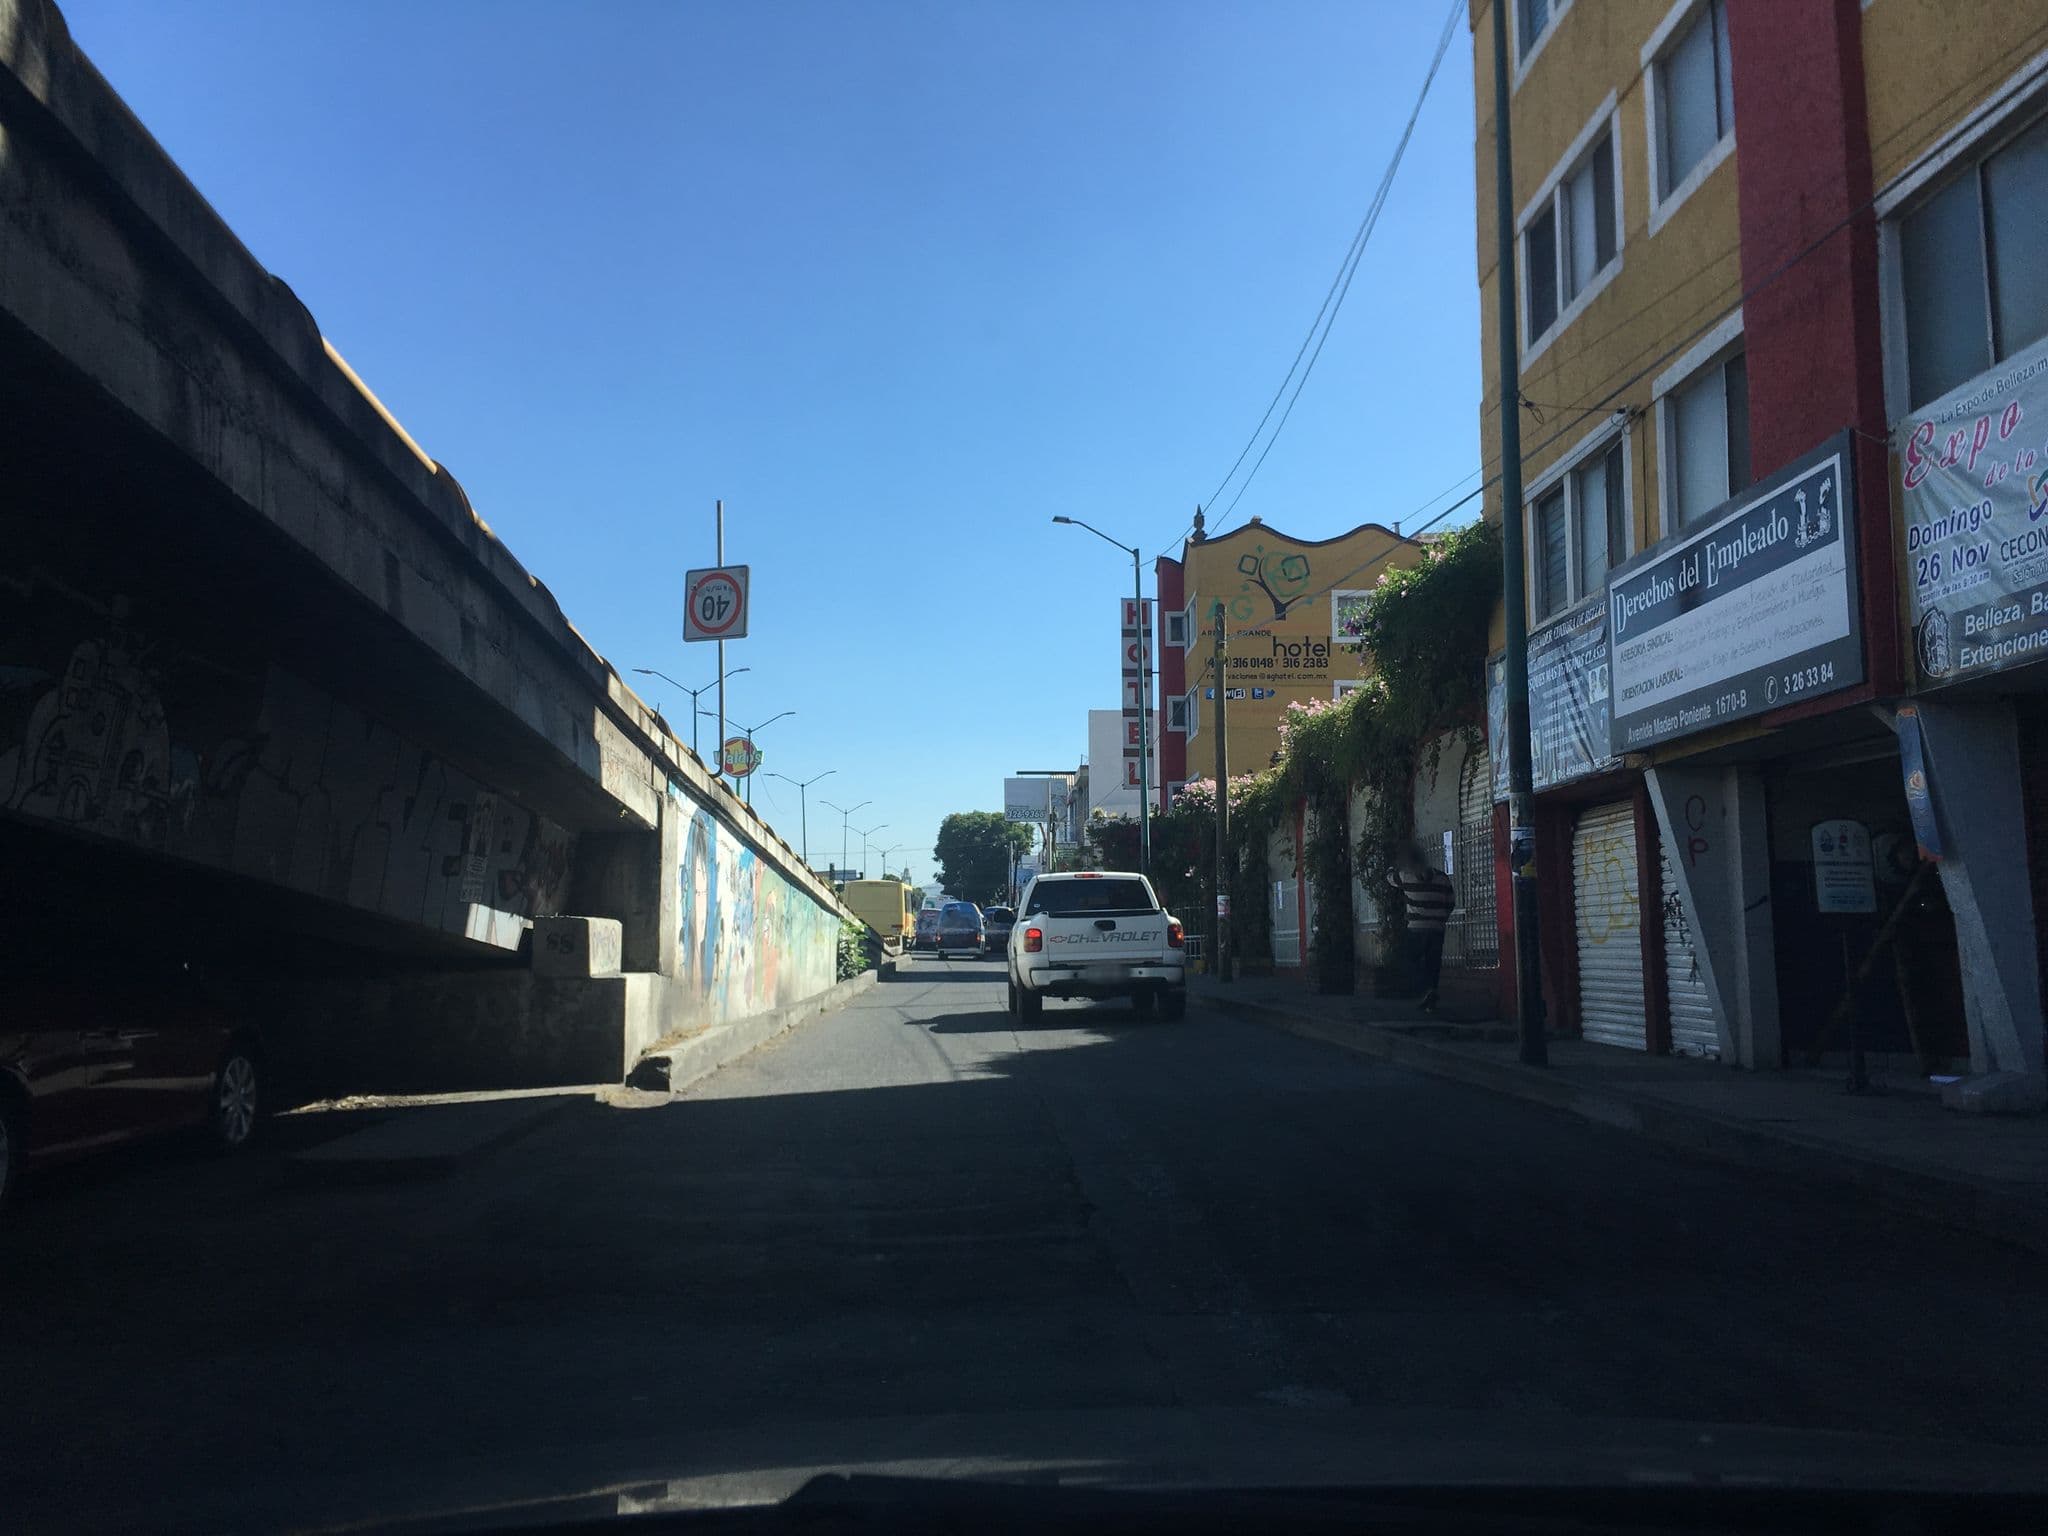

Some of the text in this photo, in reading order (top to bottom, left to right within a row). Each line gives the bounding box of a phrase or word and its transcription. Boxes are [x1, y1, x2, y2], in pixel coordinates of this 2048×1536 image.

[1955, 396, 1980, 417] Expo
[1982, 388, 1994, 403] de
[1996, 365, 2035, 393] Belleza
[1904, 400, 2022, 488] Expo
[1985, 449, 2036, 487] de la
[1909, 500, 1992, 551] Domingo
[1616, 574, 1675, 634] Derechos
[1678, 552, 1700, 592] del
[1706, 508, 1790, 589] Empleado
[1918, 542, 1990, 587] 26 Nov
[702, 595, 730, 622] 40
[1965, 603, 2025, 636] Belleza,
[1232, 657, 1248, 668] 316
[1250, 657, 1274, 668] 0148
[1282, 657, 1300, 668] 316
[1302, 657, 1329, 668] 2383
[1272, 635, 1331, 658] hotel
[1821, 660, 1834, 682] 84
[1126, 602, 1149, 785] HOTEL
[1627, 690, 1747, 744] Avenida Madero Poniente 1670-B
[1067, 930, 1162, 944] CHEVROLET
